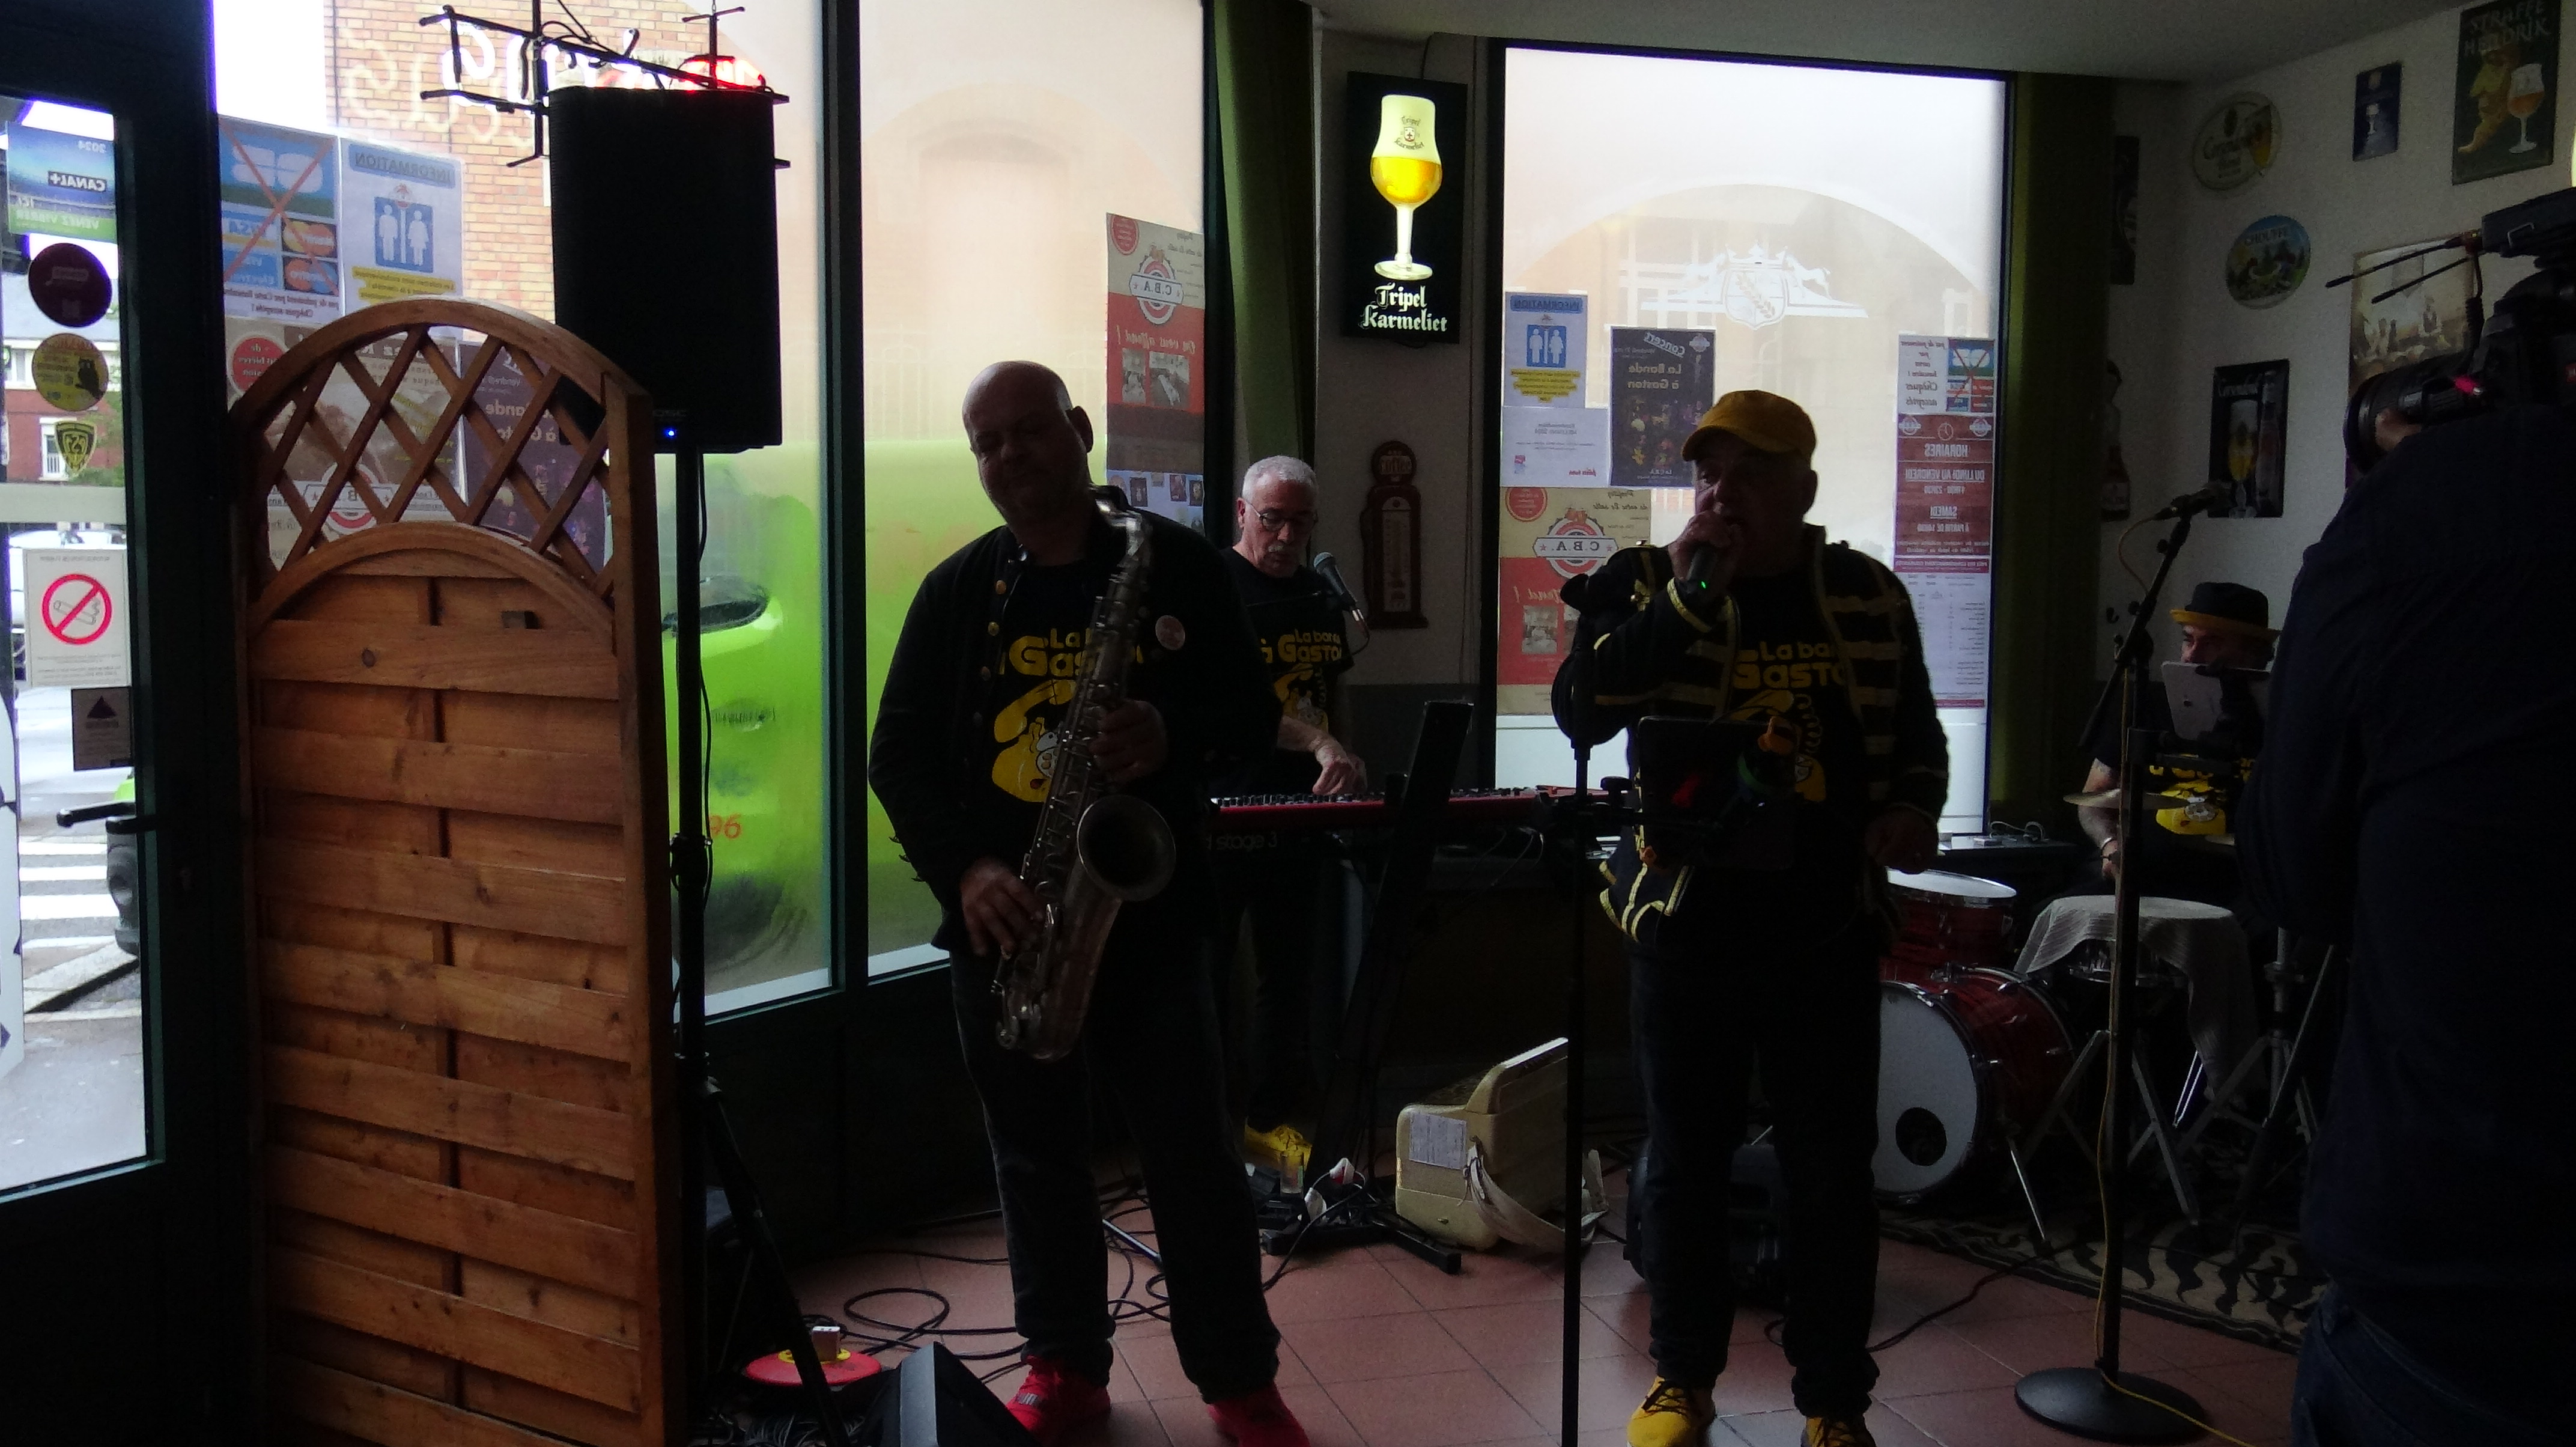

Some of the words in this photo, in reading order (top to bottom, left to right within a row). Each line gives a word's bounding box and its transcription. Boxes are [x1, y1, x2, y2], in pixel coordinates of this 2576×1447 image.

[1401, 115, 1421, 127] Tripel
[1394, 138, 1424, 150] Karmeliet
[1375, 282, 1427, 312] Tripel
[1359, 302, 1448, 332] Karmeliet
[1050, 628, 1081, 649] La
[1295, 627, 1312, 644] La
[1313, 630, 1341, 645] ban
[1759, 640, 1793, 661] La
[1797, 641, 1832, 659] ba
[1216, 833, 1265, 851] stage
[1268, 830, 1278, 848] 3
